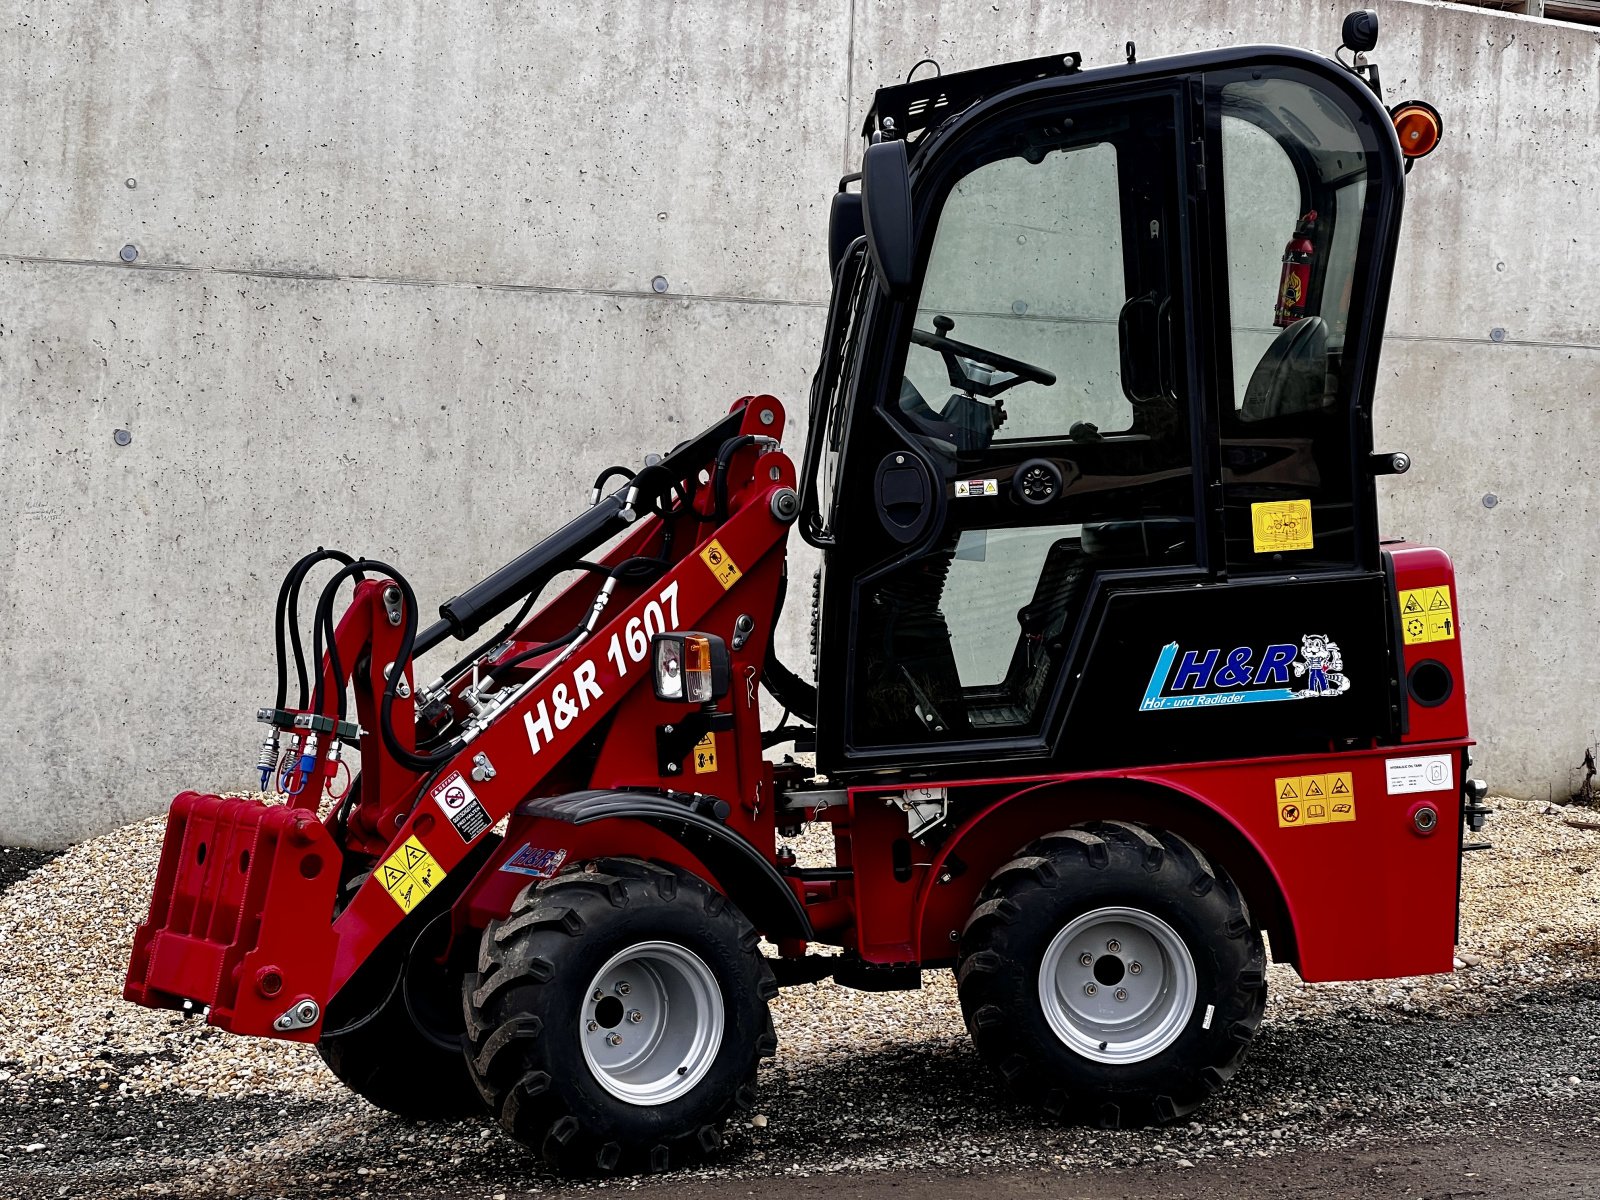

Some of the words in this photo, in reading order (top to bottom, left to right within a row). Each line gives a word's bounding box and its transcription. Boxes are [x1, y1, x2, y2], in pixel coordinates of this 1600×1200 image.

[523, 659, 604, 756] H&R
[607, 580, 680, 678] 1607
[1171, 643, 1298, 690] H&R
[1144, 697, 1166, 709] Hof
[1173, 696, 1195, 707] und
[1197, 694, 1246, 705] Radlader
[438, 773, 459, 790] GEFAHR
[512, 847, 557, 869] H&R
